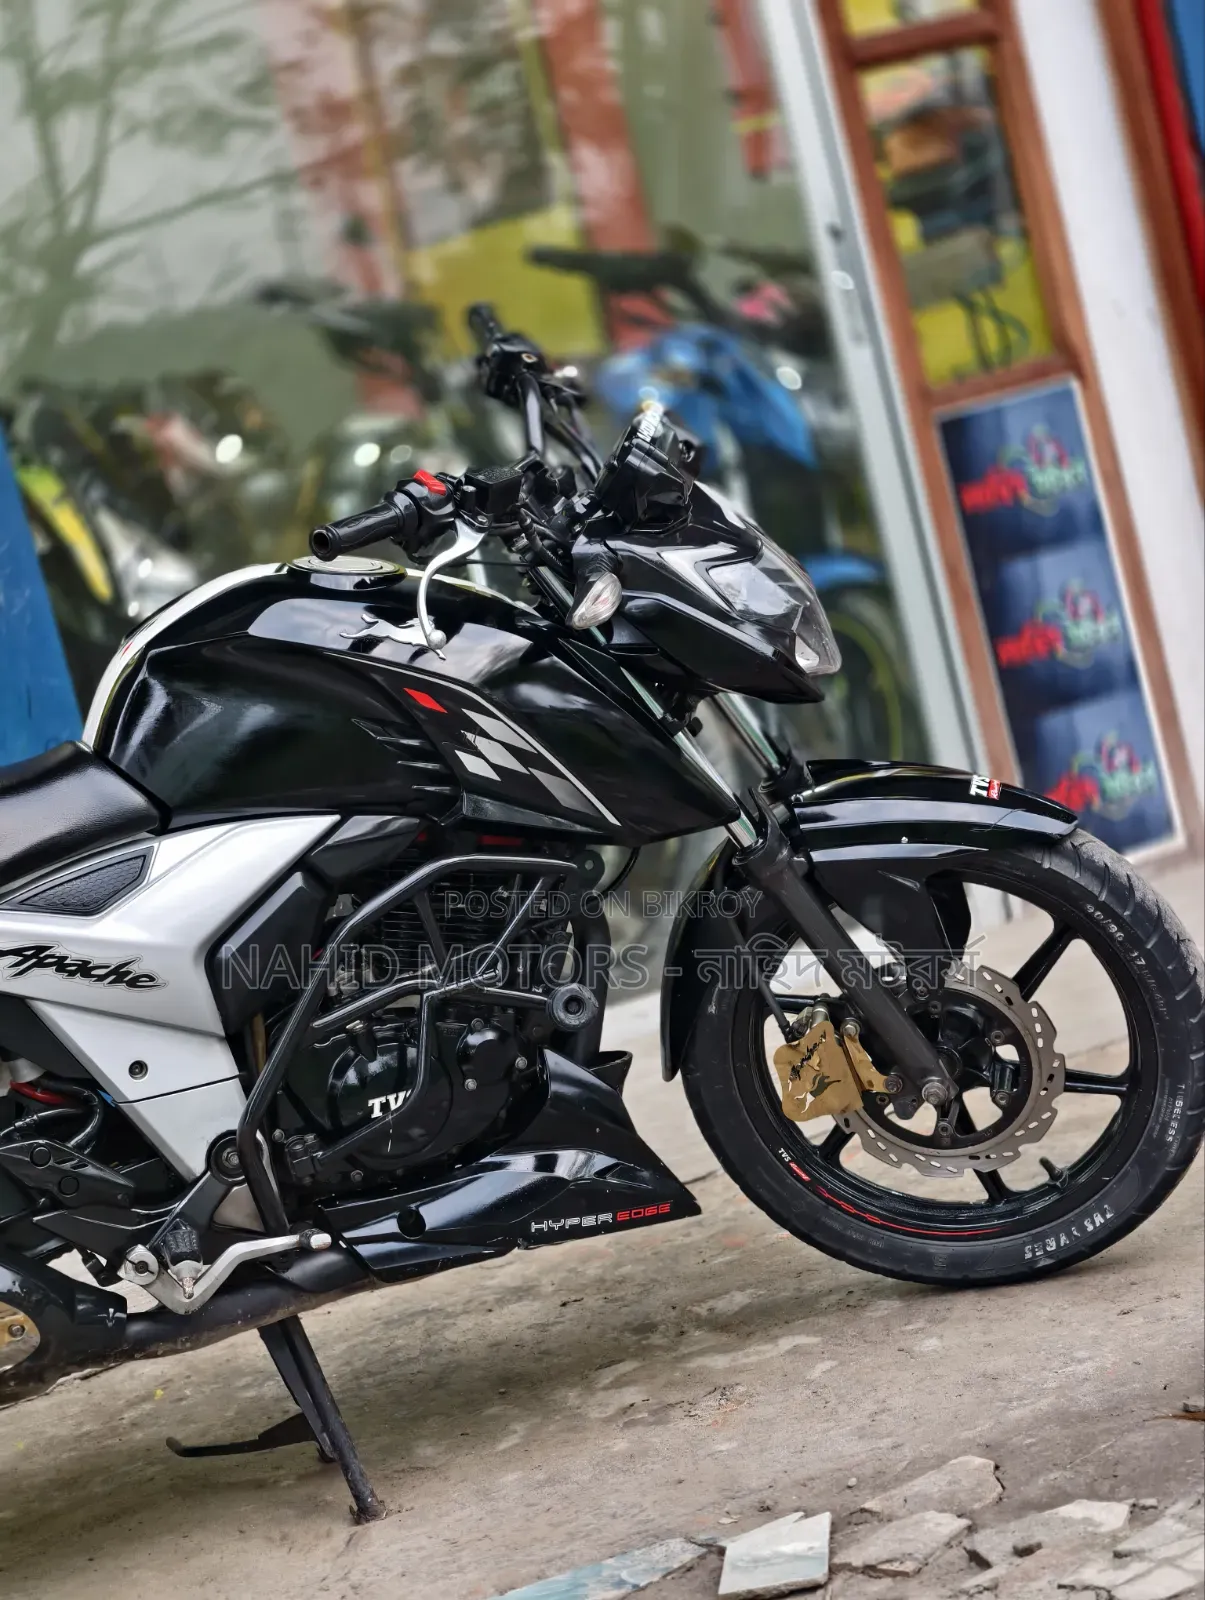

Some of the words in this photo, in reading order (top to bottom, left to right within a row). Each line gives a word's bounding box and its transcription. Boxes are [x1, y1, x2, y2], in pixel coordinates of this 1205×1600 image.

[0, 944, 166, 990] Apache
[367, 1088, 412, 1119] TV
[778, 1147, 792, 1163] TVS
[531, 1212, 613, 1233] HYPER
[616, 1203, 671, 1221] EDGE
[1083, 1204, 1115, 1232] TVS
